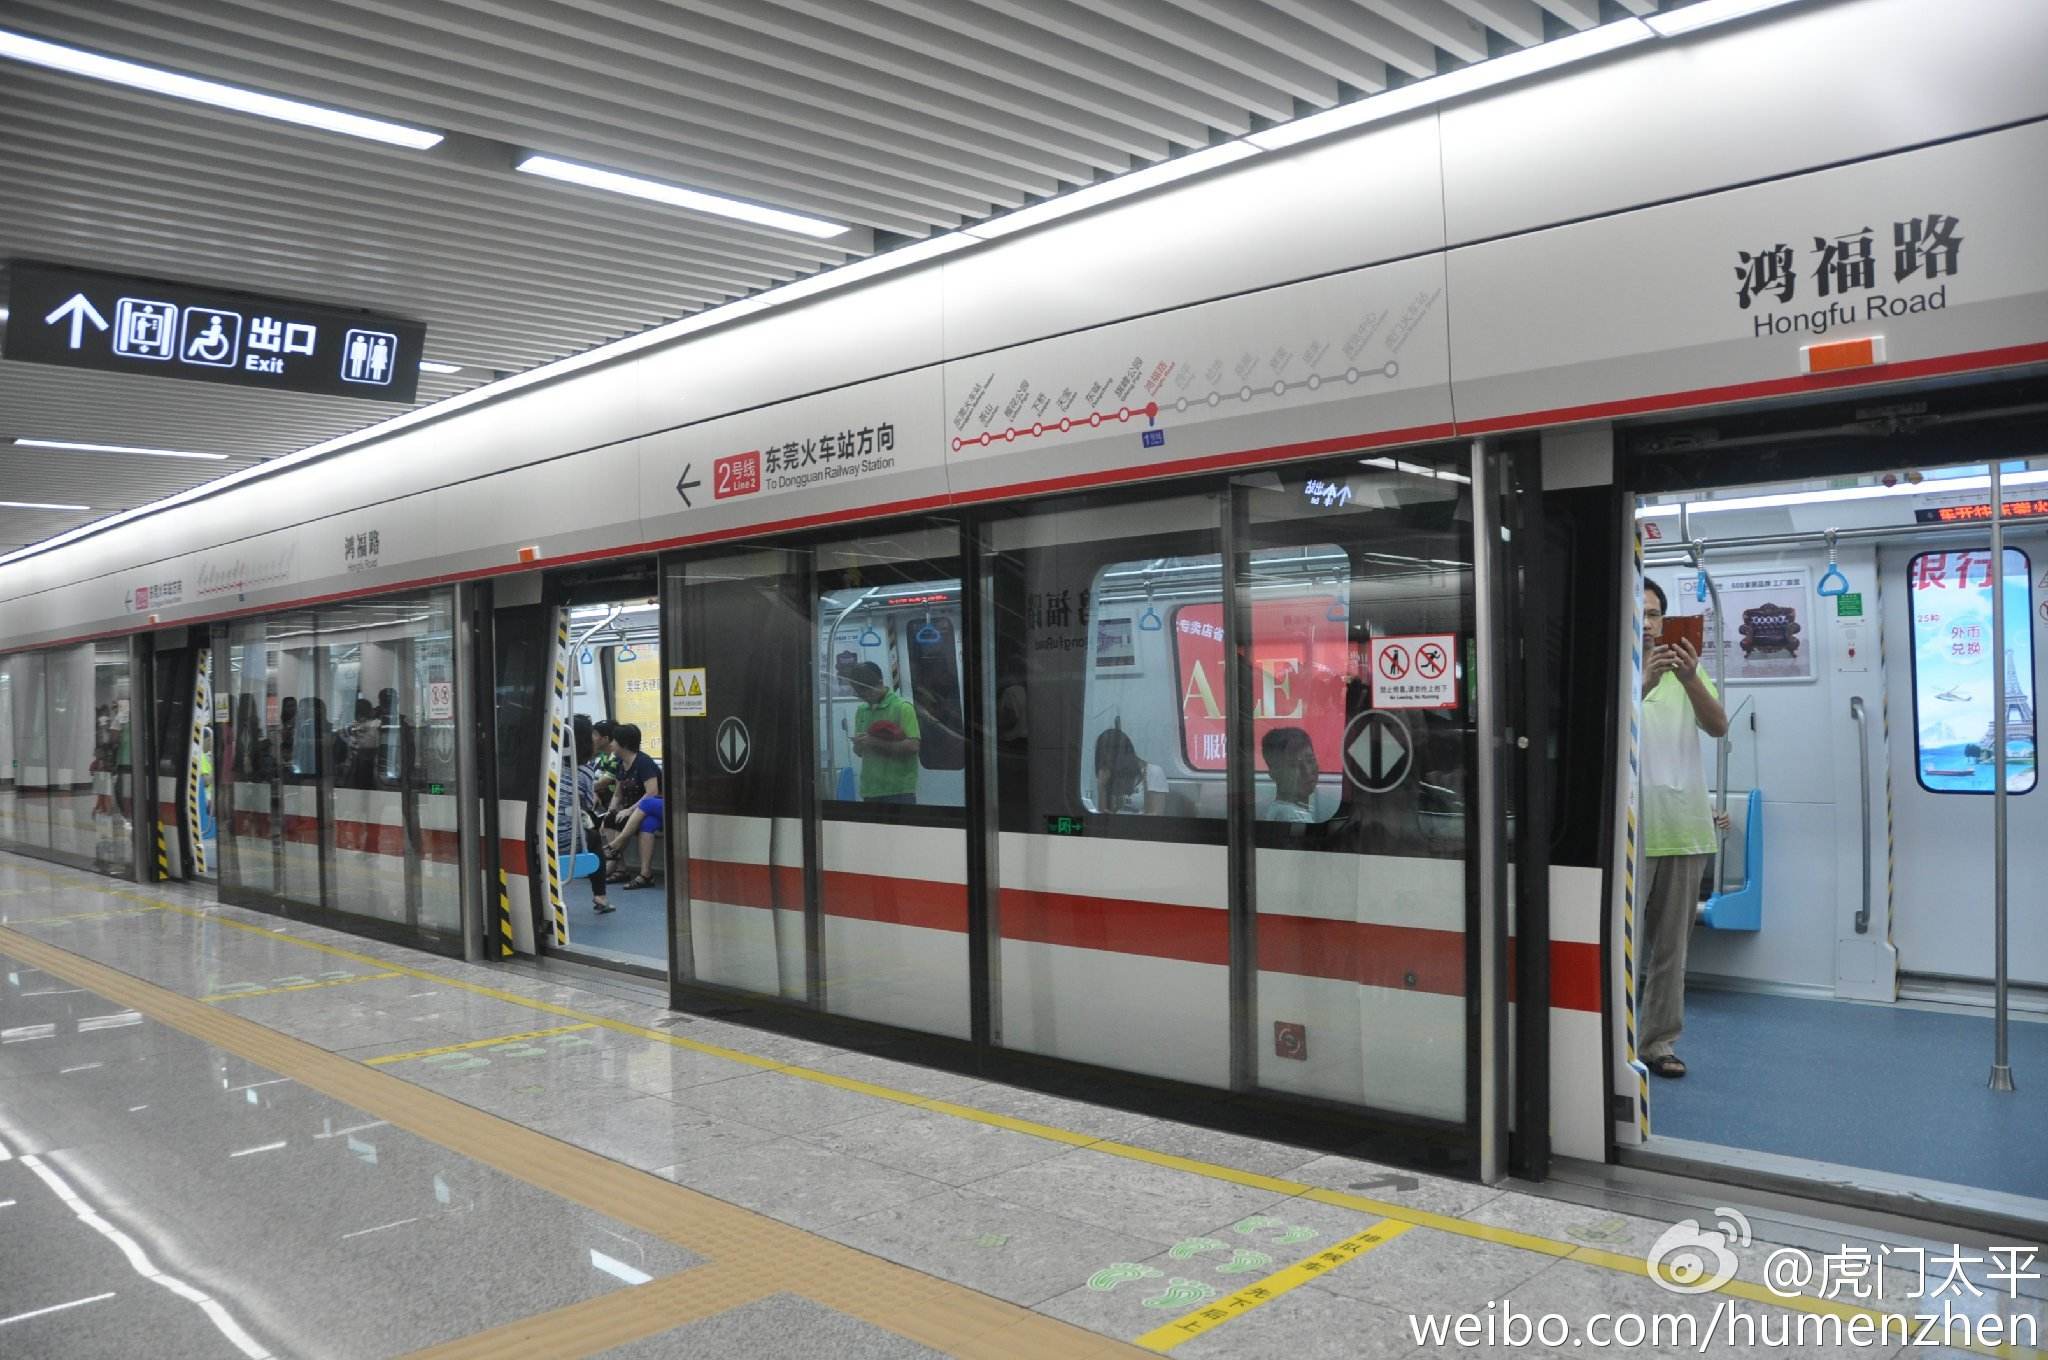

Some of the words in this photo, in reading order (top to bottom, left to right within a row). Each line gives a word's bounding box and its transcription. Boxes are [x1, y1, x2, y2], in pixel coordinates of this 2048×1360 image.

[1734, 214, 1965, 310] 鸿福路
[1754, 302, 1856, 338] Hongfu
[1866, 285, 1947, 320] Road
[247, 316, 317, 356] 出口
[245, 354, 284, 374] Exit
[766, 422, 894, 474] 东莞火车站方向
[719, 459, 756, 494] 2号线
[766, 478, 778, 490] To
[779, 470, 824, 488] Dongguan
[825, 463, 860, 480] Railway
[861, 457, 895, 473] Station
[1183, 658, 1303, 719] AE
[1174, 1287, 1272, 1333] 先下后上
